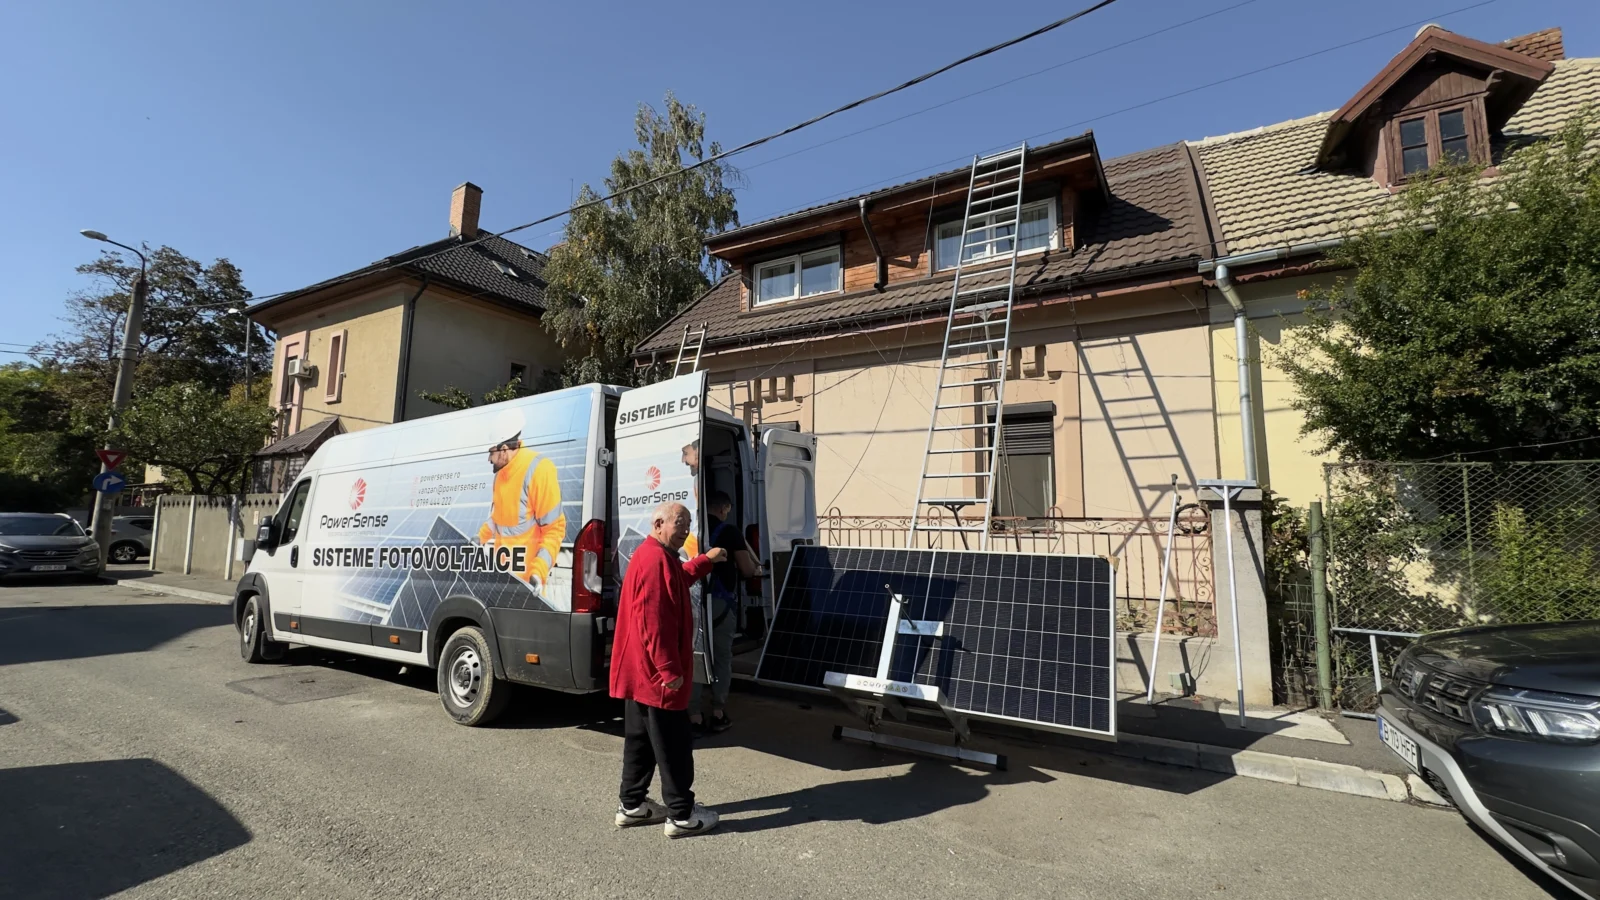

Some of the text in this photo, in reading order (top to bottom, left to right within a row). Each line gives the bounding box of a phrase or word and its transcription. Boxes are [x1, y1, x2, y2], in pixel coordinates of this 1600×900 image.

[619, 394, 701, 425] SISTEME FO
[420, 472, 460, 483] powersensero
[418, 482, 486, 495] vanzari@powersensero
[620, 491, 689, 507] PowerSense
[320, 513, 389, 529] PowerSense
[313, 547, 526, 571] SISTEME FOTOVOLTAICE
[1383, 723, 1389, 741] B
